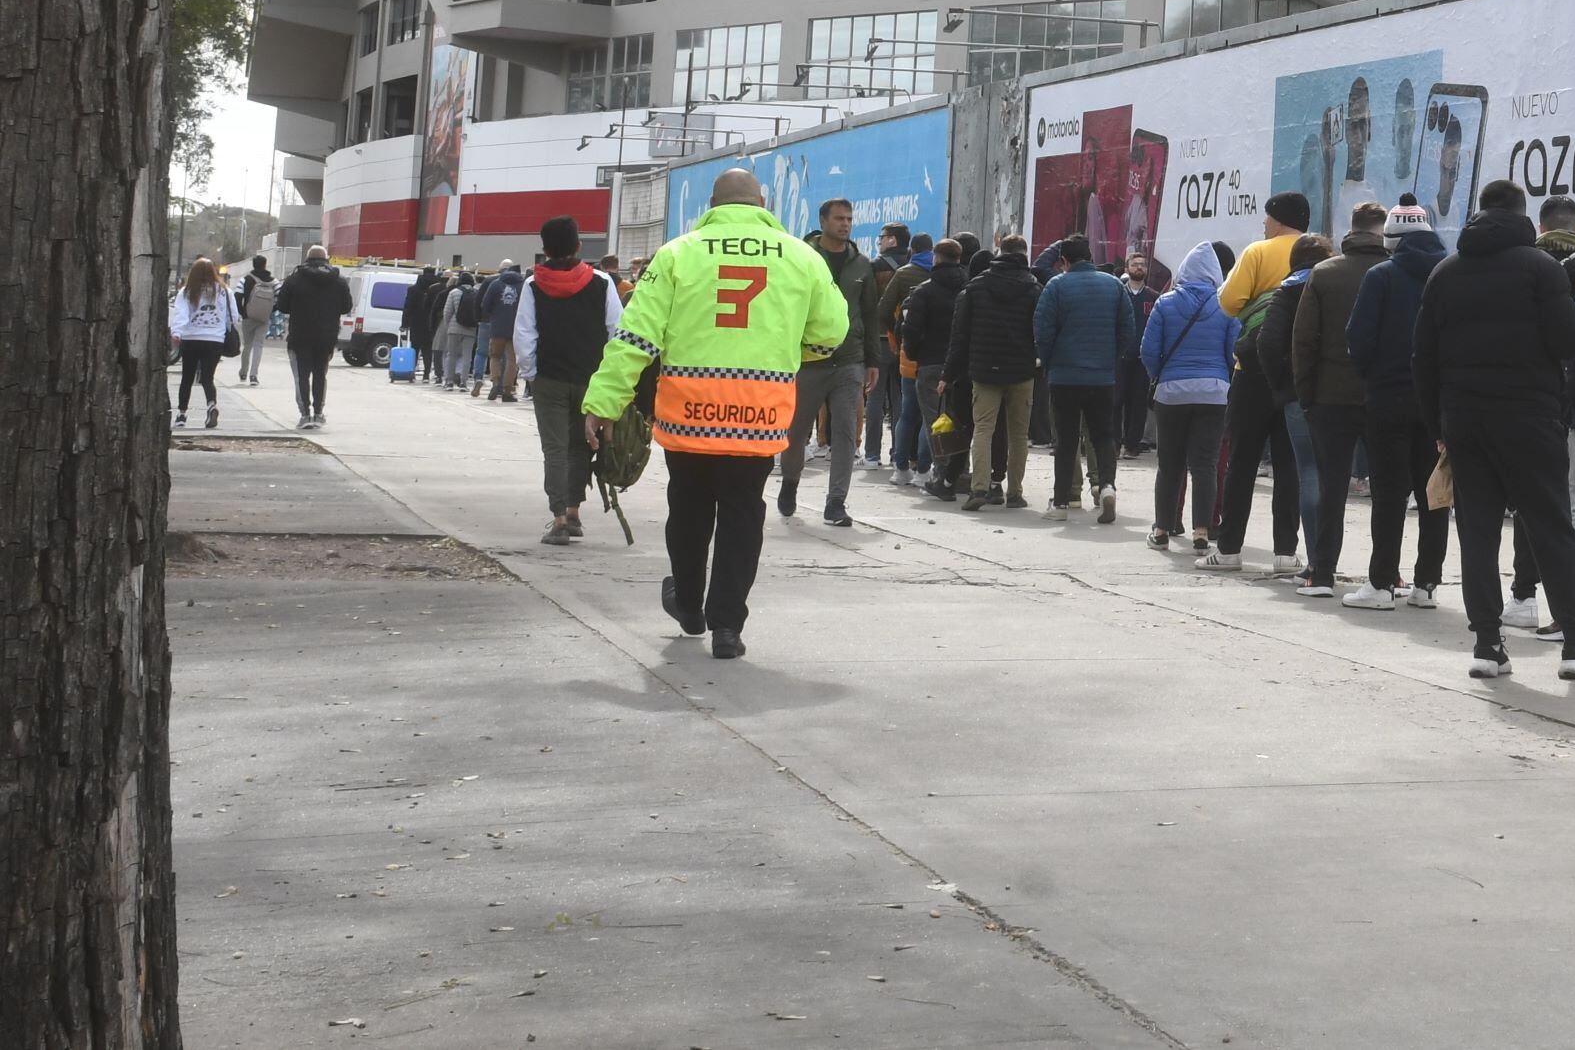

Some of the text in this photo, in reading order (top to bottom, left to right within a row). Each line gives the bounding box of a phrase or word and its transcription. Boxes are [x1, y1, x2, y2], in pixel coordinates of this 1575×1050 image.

[1511, 91, 1559, 120] NUEVO
[1047, 116, 1080, 139] motorola
[1179, 138, 1208, 158] NUEVO
[1176, 169, 1241, 220] razr 40
[1227, 193, 1258, 216] ULTRA
[882, 194, 919, 223] FAVORITAS
[702, 237, 784, 258] TECH
[684, 401, 777, 425] SEGURIDAD
